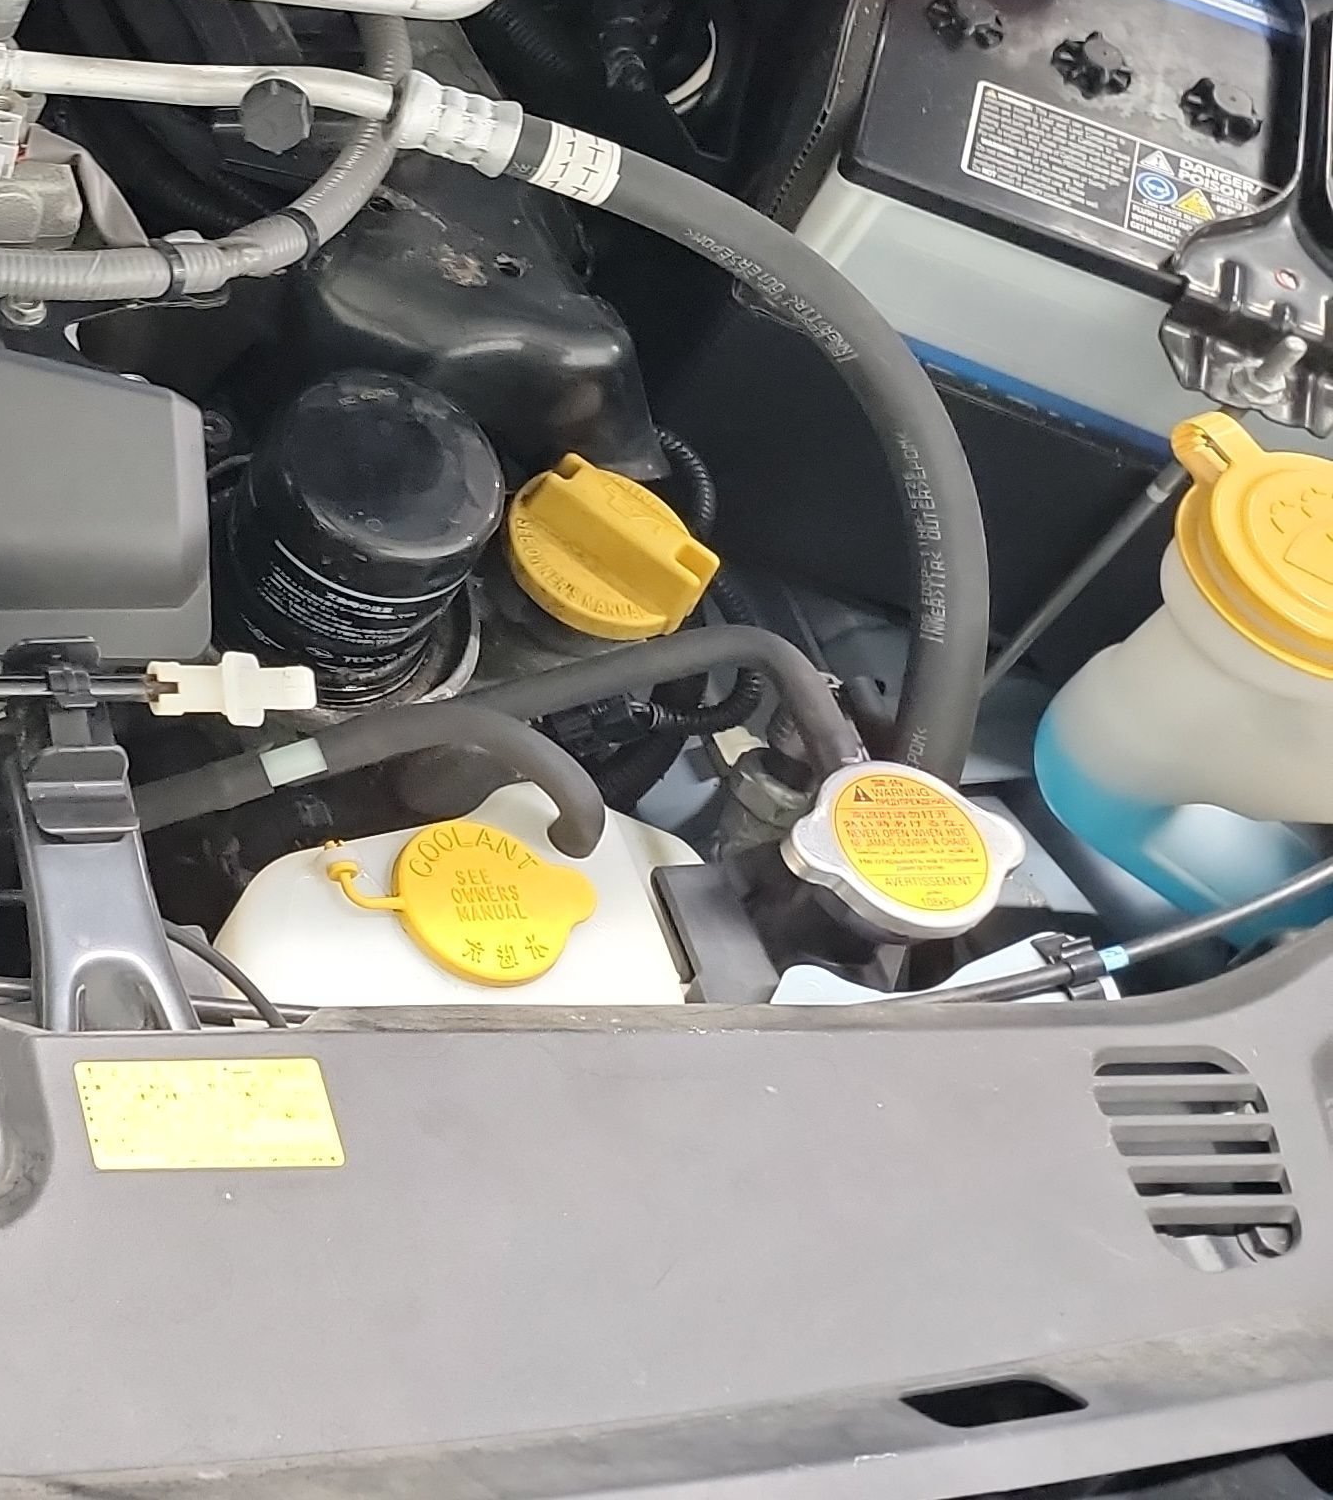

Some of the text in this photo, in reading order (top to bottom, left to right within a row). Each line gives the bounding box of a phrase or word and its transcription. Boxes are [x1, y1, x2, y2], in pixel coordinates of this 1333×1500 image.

[1178, 170, 1249, 202] POISON
[1179, 157, 1262, 197] DANGER/
[871, 786, 930, 798] WARNING
[846, 828, 966, 838] NEVER OPEN WHEN HOT
[409, 826, 539, 878] COOLANT
[455, 868, 492, 886] SEE
[884, 875, 973, 887] AVERTISSEMENT
[451, 885, 520, 905] OWNERS
[455, 903, 529, 923] MANUAL
